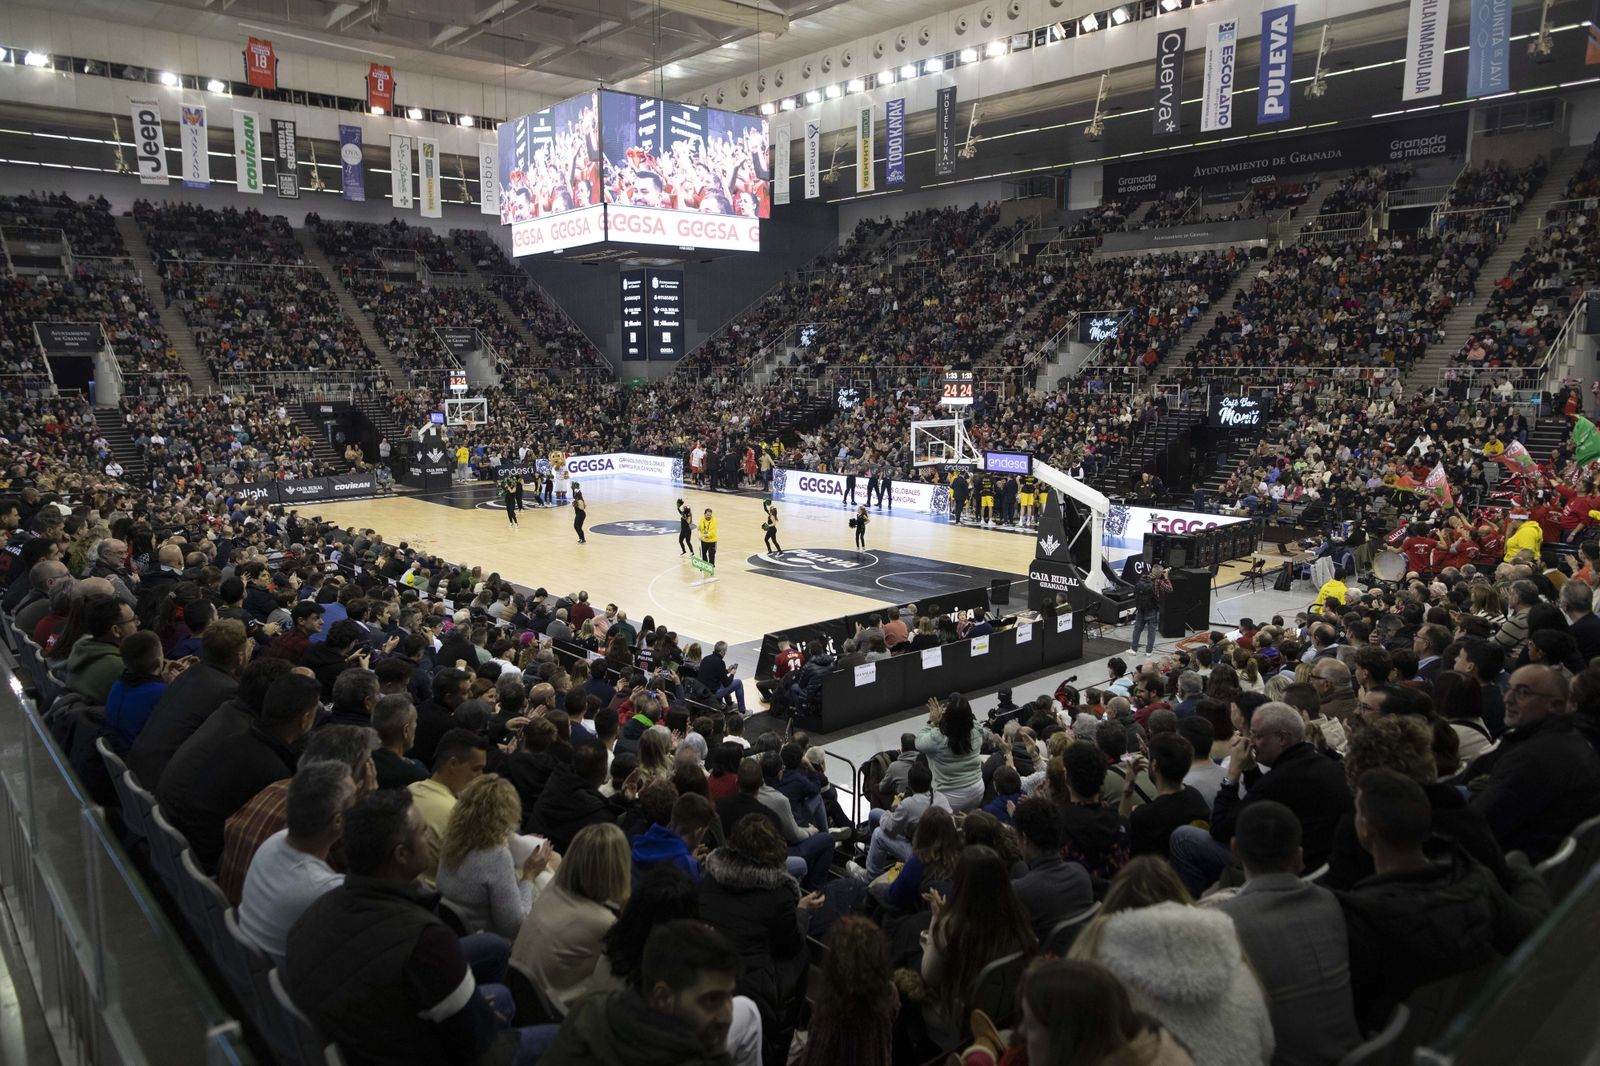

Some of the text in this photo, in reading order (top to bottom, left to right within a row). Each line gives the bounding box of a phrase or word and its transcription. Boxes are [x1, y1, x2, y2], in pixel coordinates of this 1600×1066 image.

[255, 54, 267, 69] 18
[1264, 14, 1289, 115] PULEVA
[1415, 19, 1436, 94] INMACULADA
[378, 79, 384, 91] 8
[888, 99, 903, 137] KAYAK
[138, 110, 162, 173] Jeep
[284, 122, 296, 170] BURGERS
[1390, 134, 1447, 150] Granada
[241, 115, 257, 190] COVIRAN
[888, 137, 903, 169] TODO
[1390, 144, 1446, 159] es música
[1193, 149, 1342, 177] AYUNTAMIENTO DE GRANADA
[483, 155, 493, 202] niobio
[1118, 173, 1157, 186] Granada
[1127, 182, 1156, 194] deporte
[944, 384, 972, 397] 24 24
[944, 464, 970, 472] endesa
[988, 457, 1027, 470] endesa
[1030, 571, 1080, 587] CAJA RURAL
[1040, 582, 1069, 592] GRANADA
